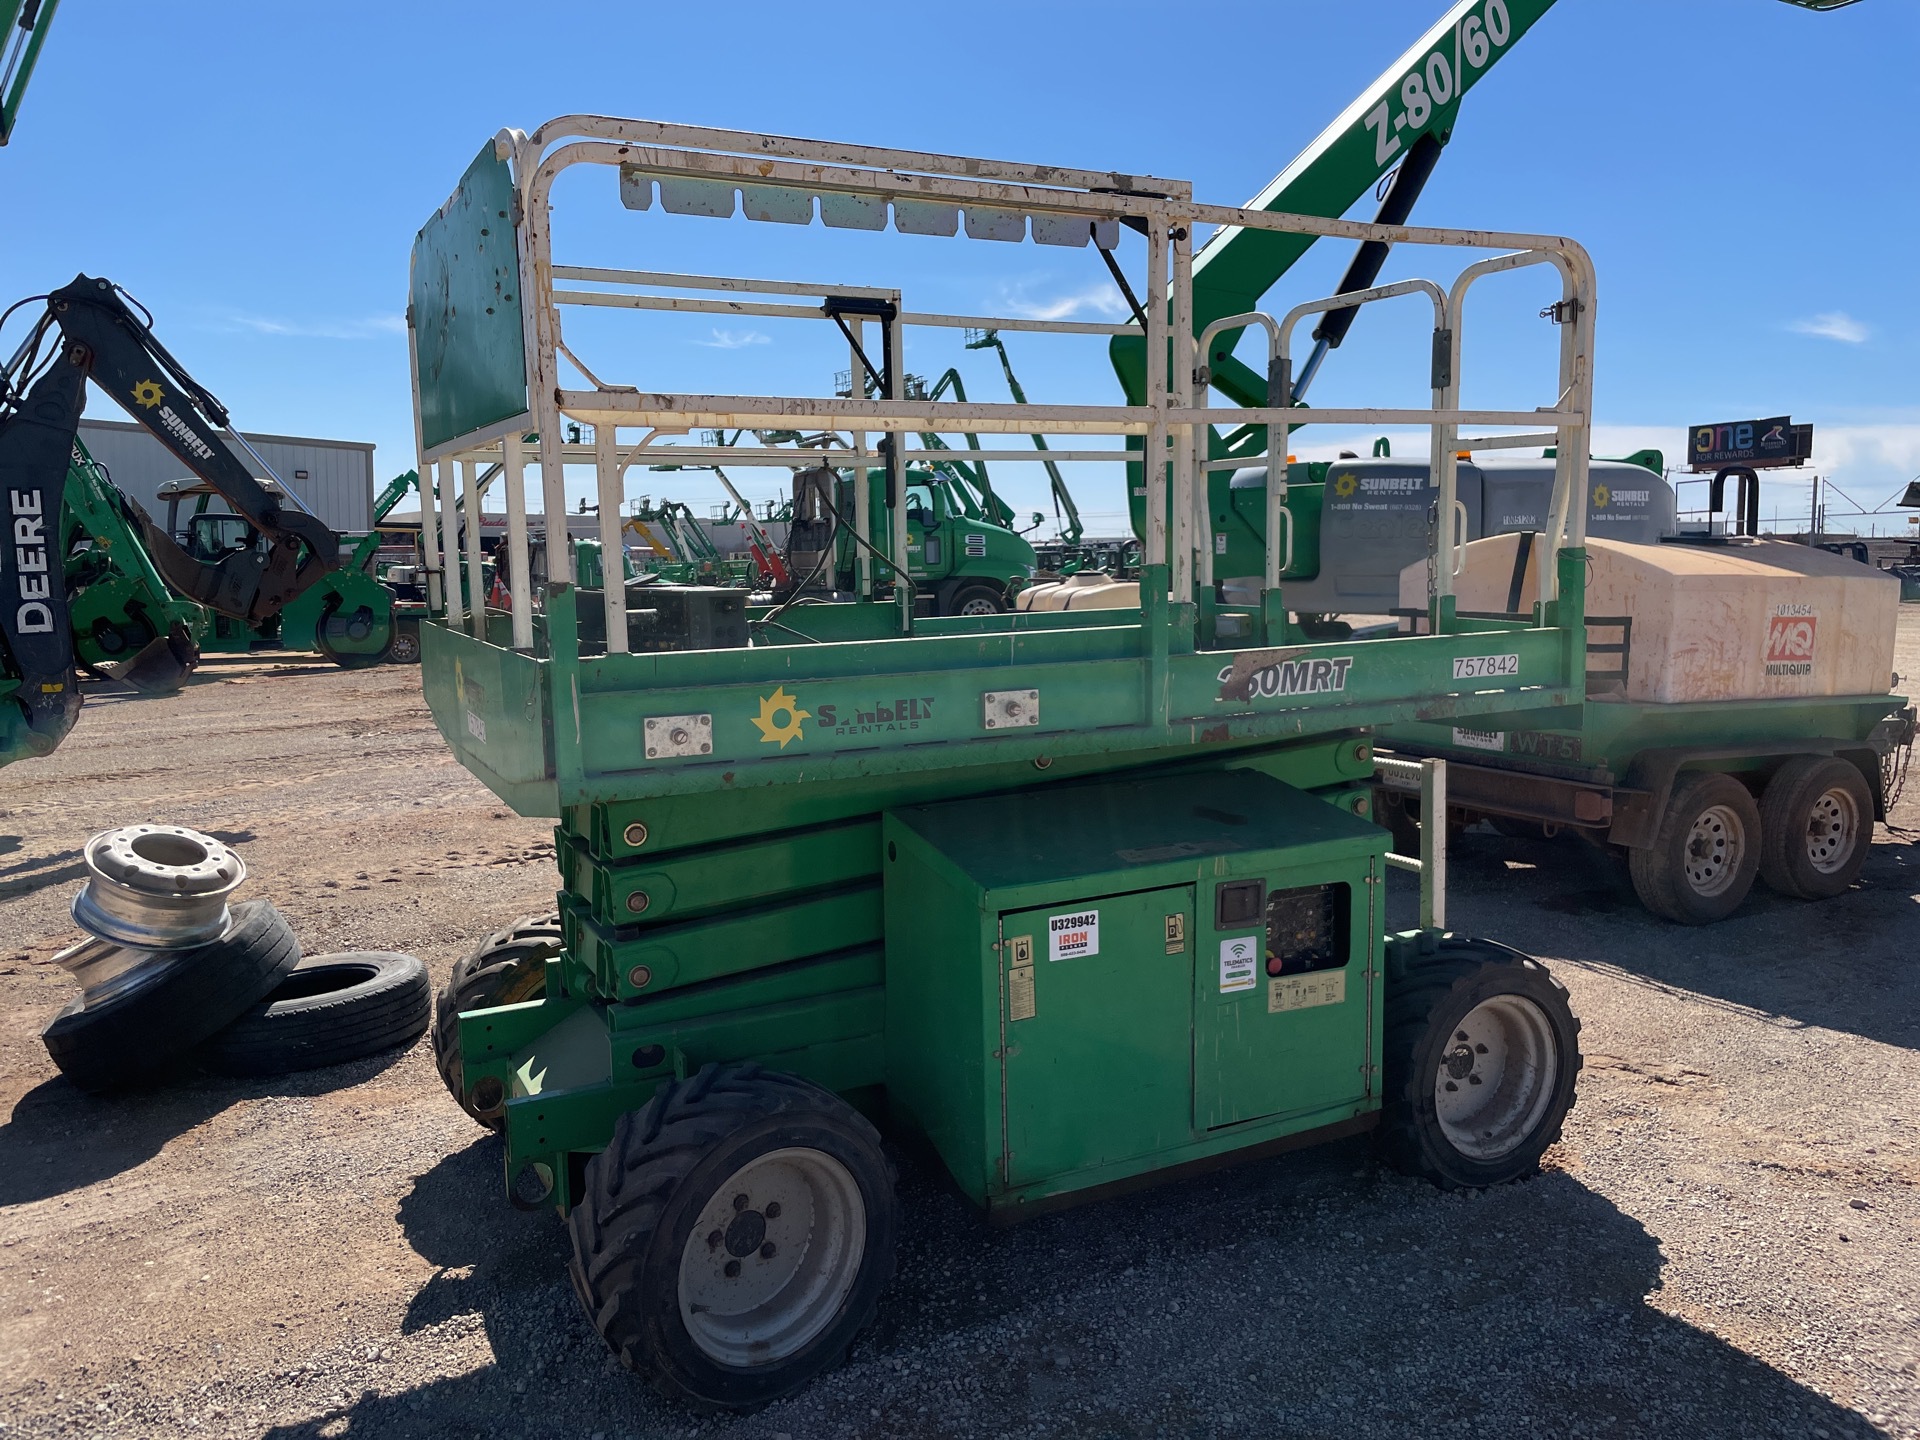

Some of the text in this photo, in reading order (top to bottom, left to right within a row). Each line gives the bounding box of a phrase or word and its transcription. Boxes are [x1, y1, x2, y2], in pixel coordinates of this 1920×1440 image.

[1364, 0, 1511, 167] Z-80/60
[159, 405, 214, 459] SUNBELT
[161, 420, 199, 457] RENTALS
[1696, 424, 1753, 453] one
[1695, 449, 1755, 461] FOR REWARDS
[1360, 478, 1423, 490] SUNBELT
[1611, 490, 1650, 501] SUNBELT
[10, 489, 54, 634] DEERE
[1776, 604, 1812, 616] 1013454
[1763, 622, 1813, 656] MQ
[1454, 656, 1518, 677] 757842
[1766, 664, 1811, 676] MULTIQUIP
[835, 721, 919, 736] RENTALS
[1051, 914, 1096, 931] U329942
[1058, 931, 1088, 945] IRON
[1223, 957, 1253, 967] TELEMATICS
